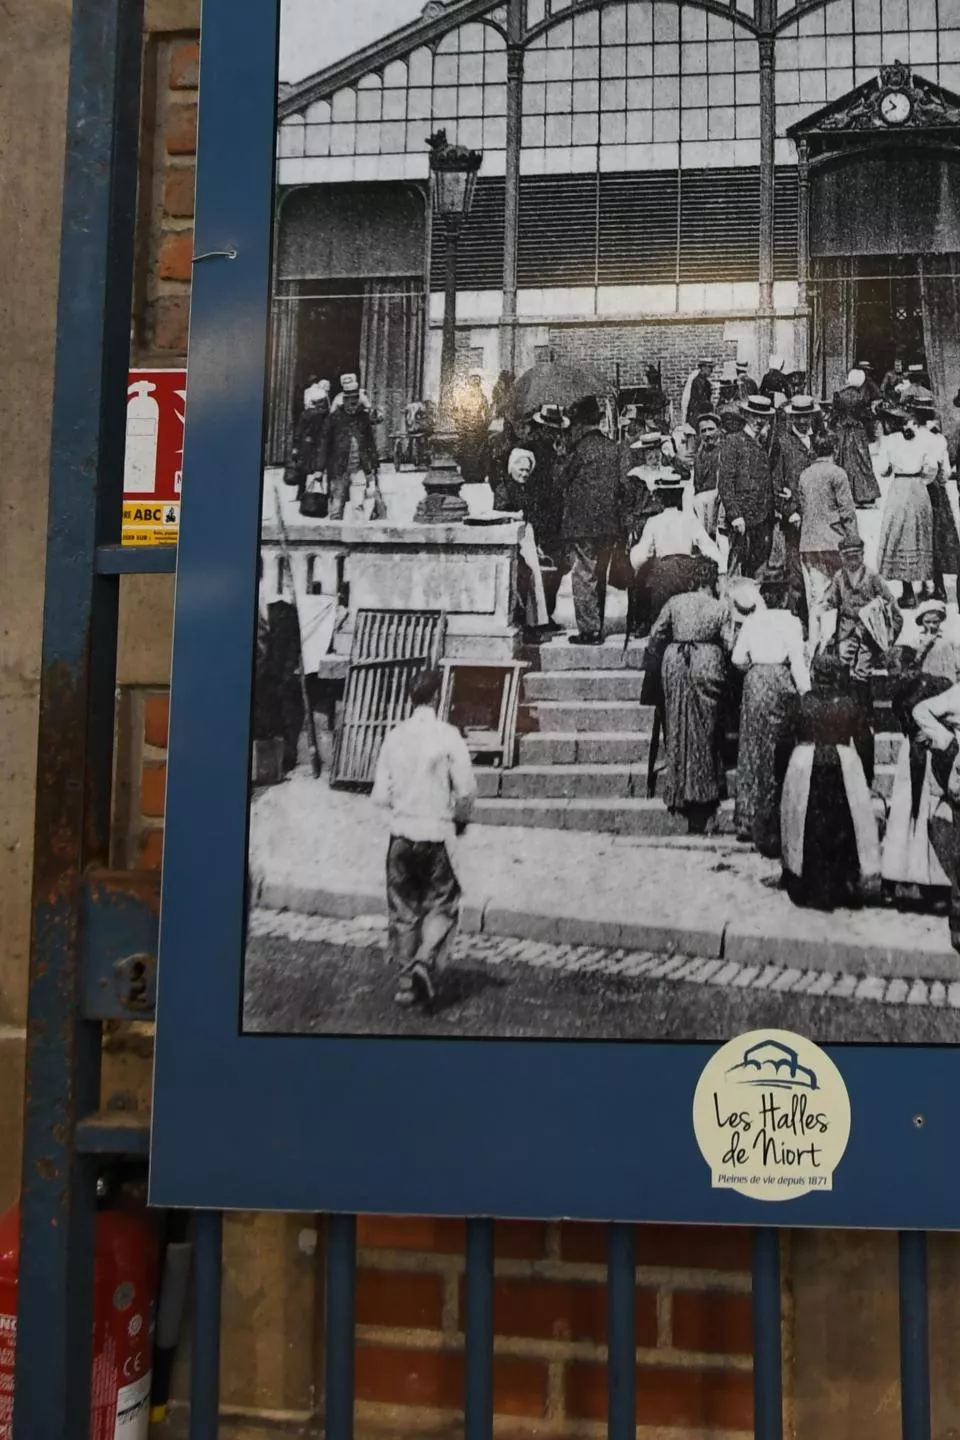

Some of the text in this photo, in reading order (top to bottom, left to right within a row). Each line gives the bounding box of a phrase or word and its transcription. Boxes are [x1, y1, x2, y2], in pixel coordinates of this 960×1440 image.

[134, 509, 161, 521] ABC
[714, 1092, 830, 1136] Les Halles
[722, 1128, 822, 1167] de Niort
[718, 1174, 827, 1186] Pleines de vie depuis 1871
